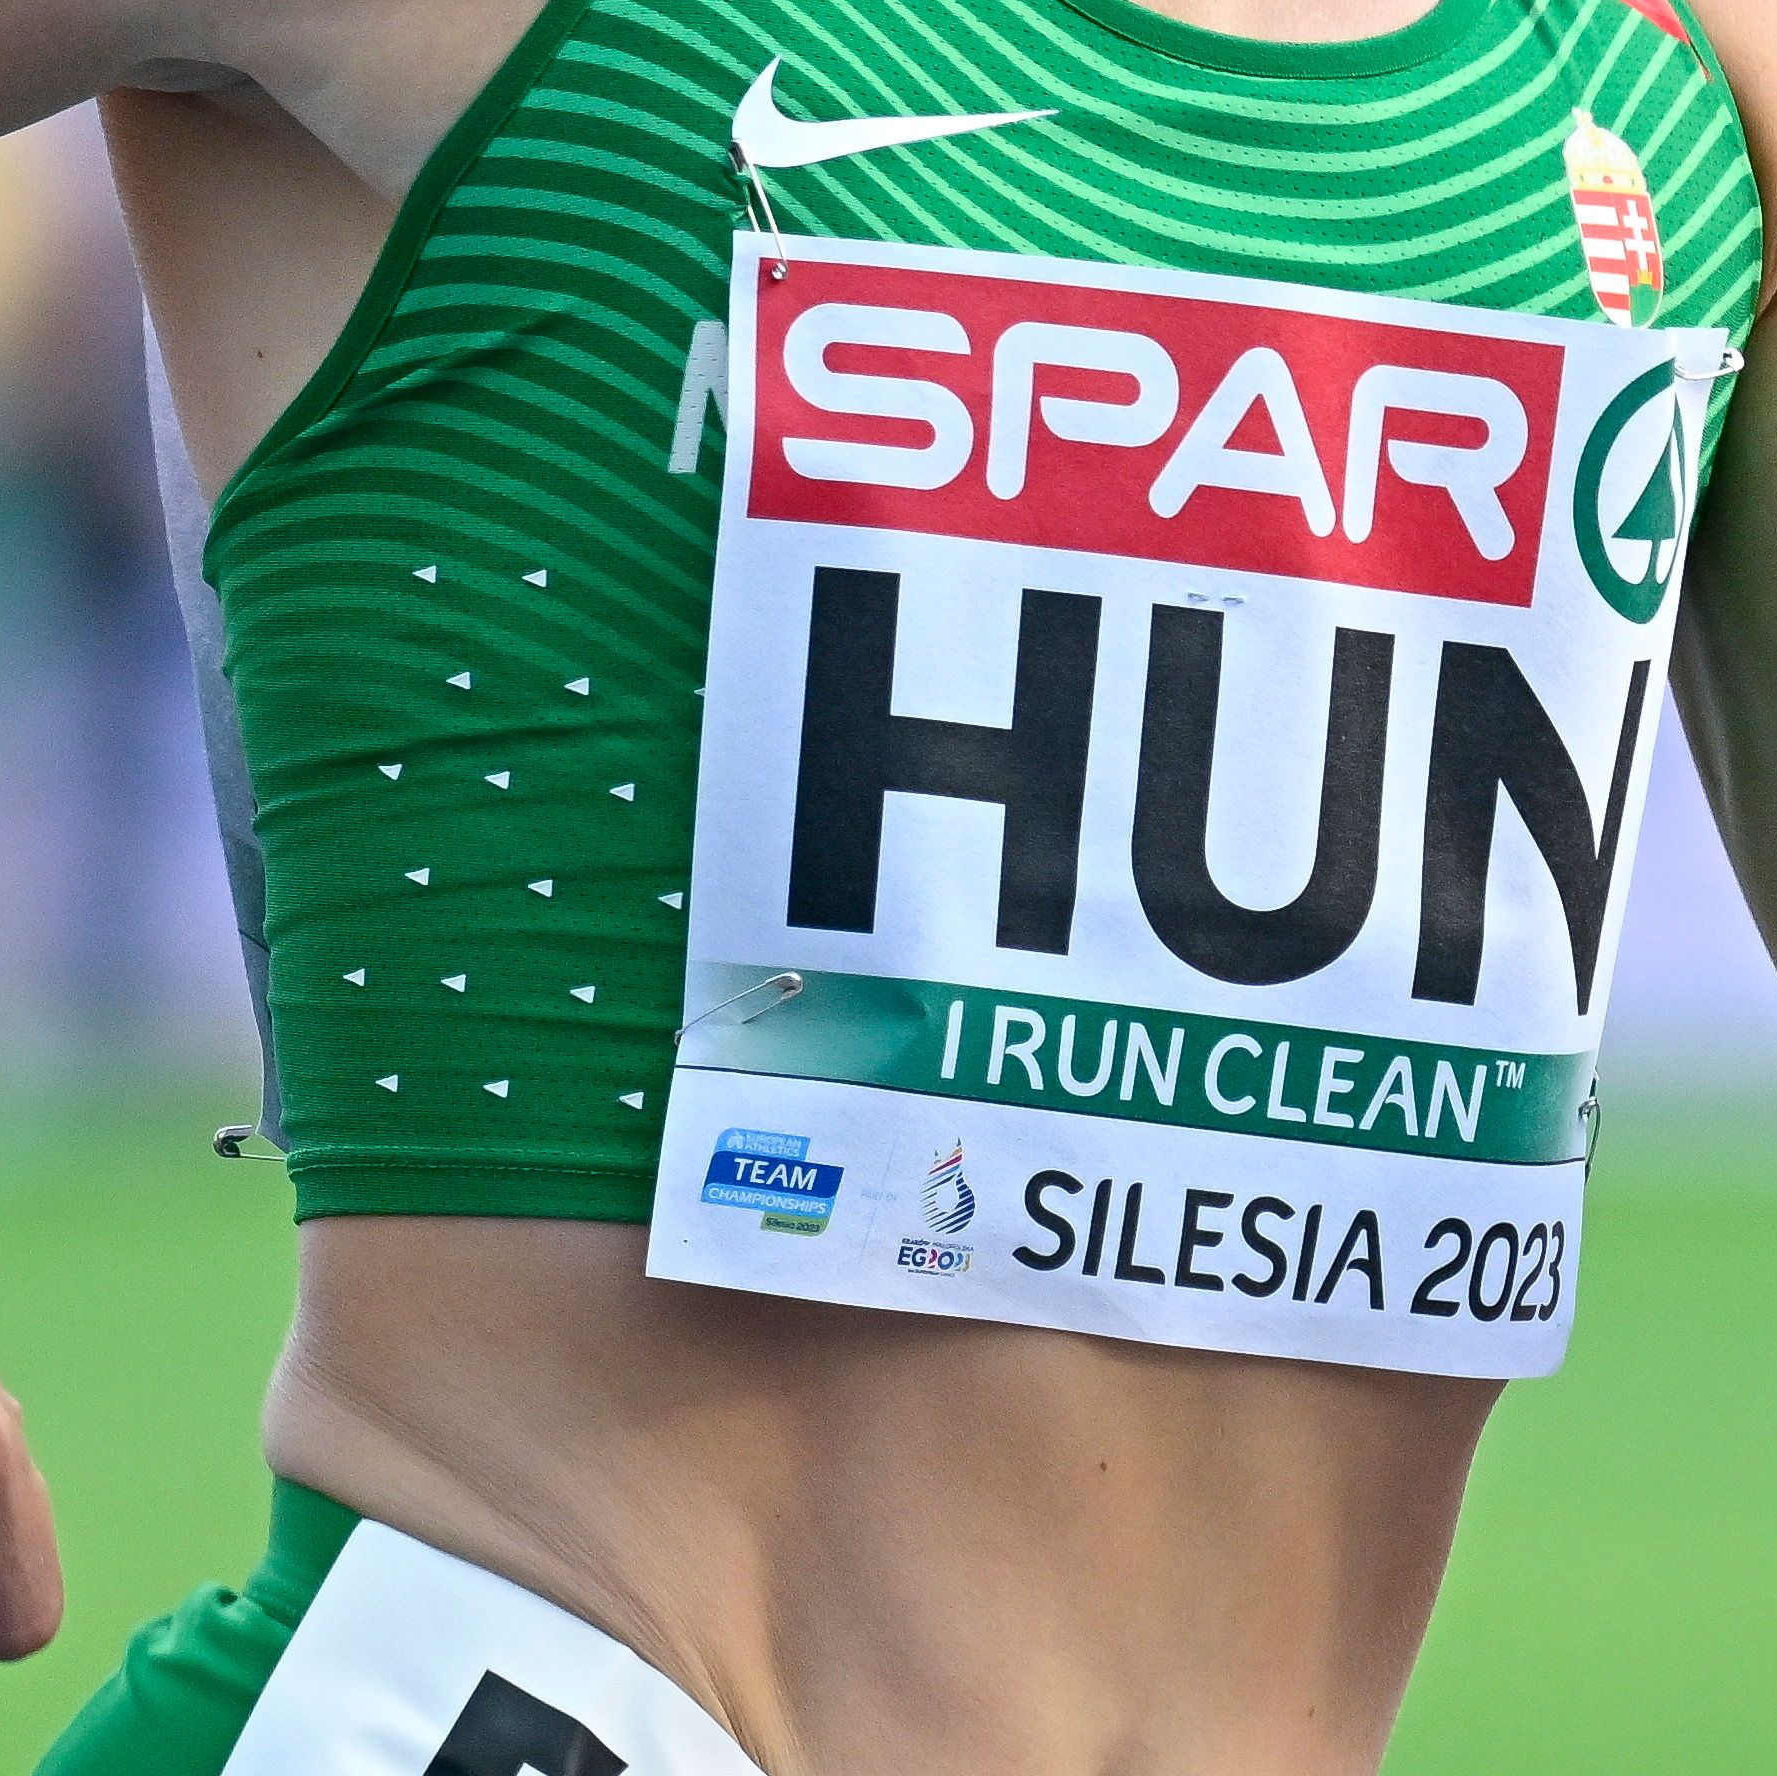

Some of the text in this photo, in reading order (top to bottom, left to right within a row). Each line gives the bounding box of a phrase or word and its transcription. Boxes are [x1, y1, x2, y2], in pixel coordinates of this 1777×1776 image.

[782, 301, 1530, 562] SPAR
[786, 566, 1650, 1018] HUN
[940, 999, 965, 1080] I
[987, 1005, 1185, 1105] RUN
[708, 1187, 827, 1214] CHAMPIONSHIPS
[733, 1157, 818, 1191] TEAM
[1012, 1168, 1567, 1322] SILESIA 2023
